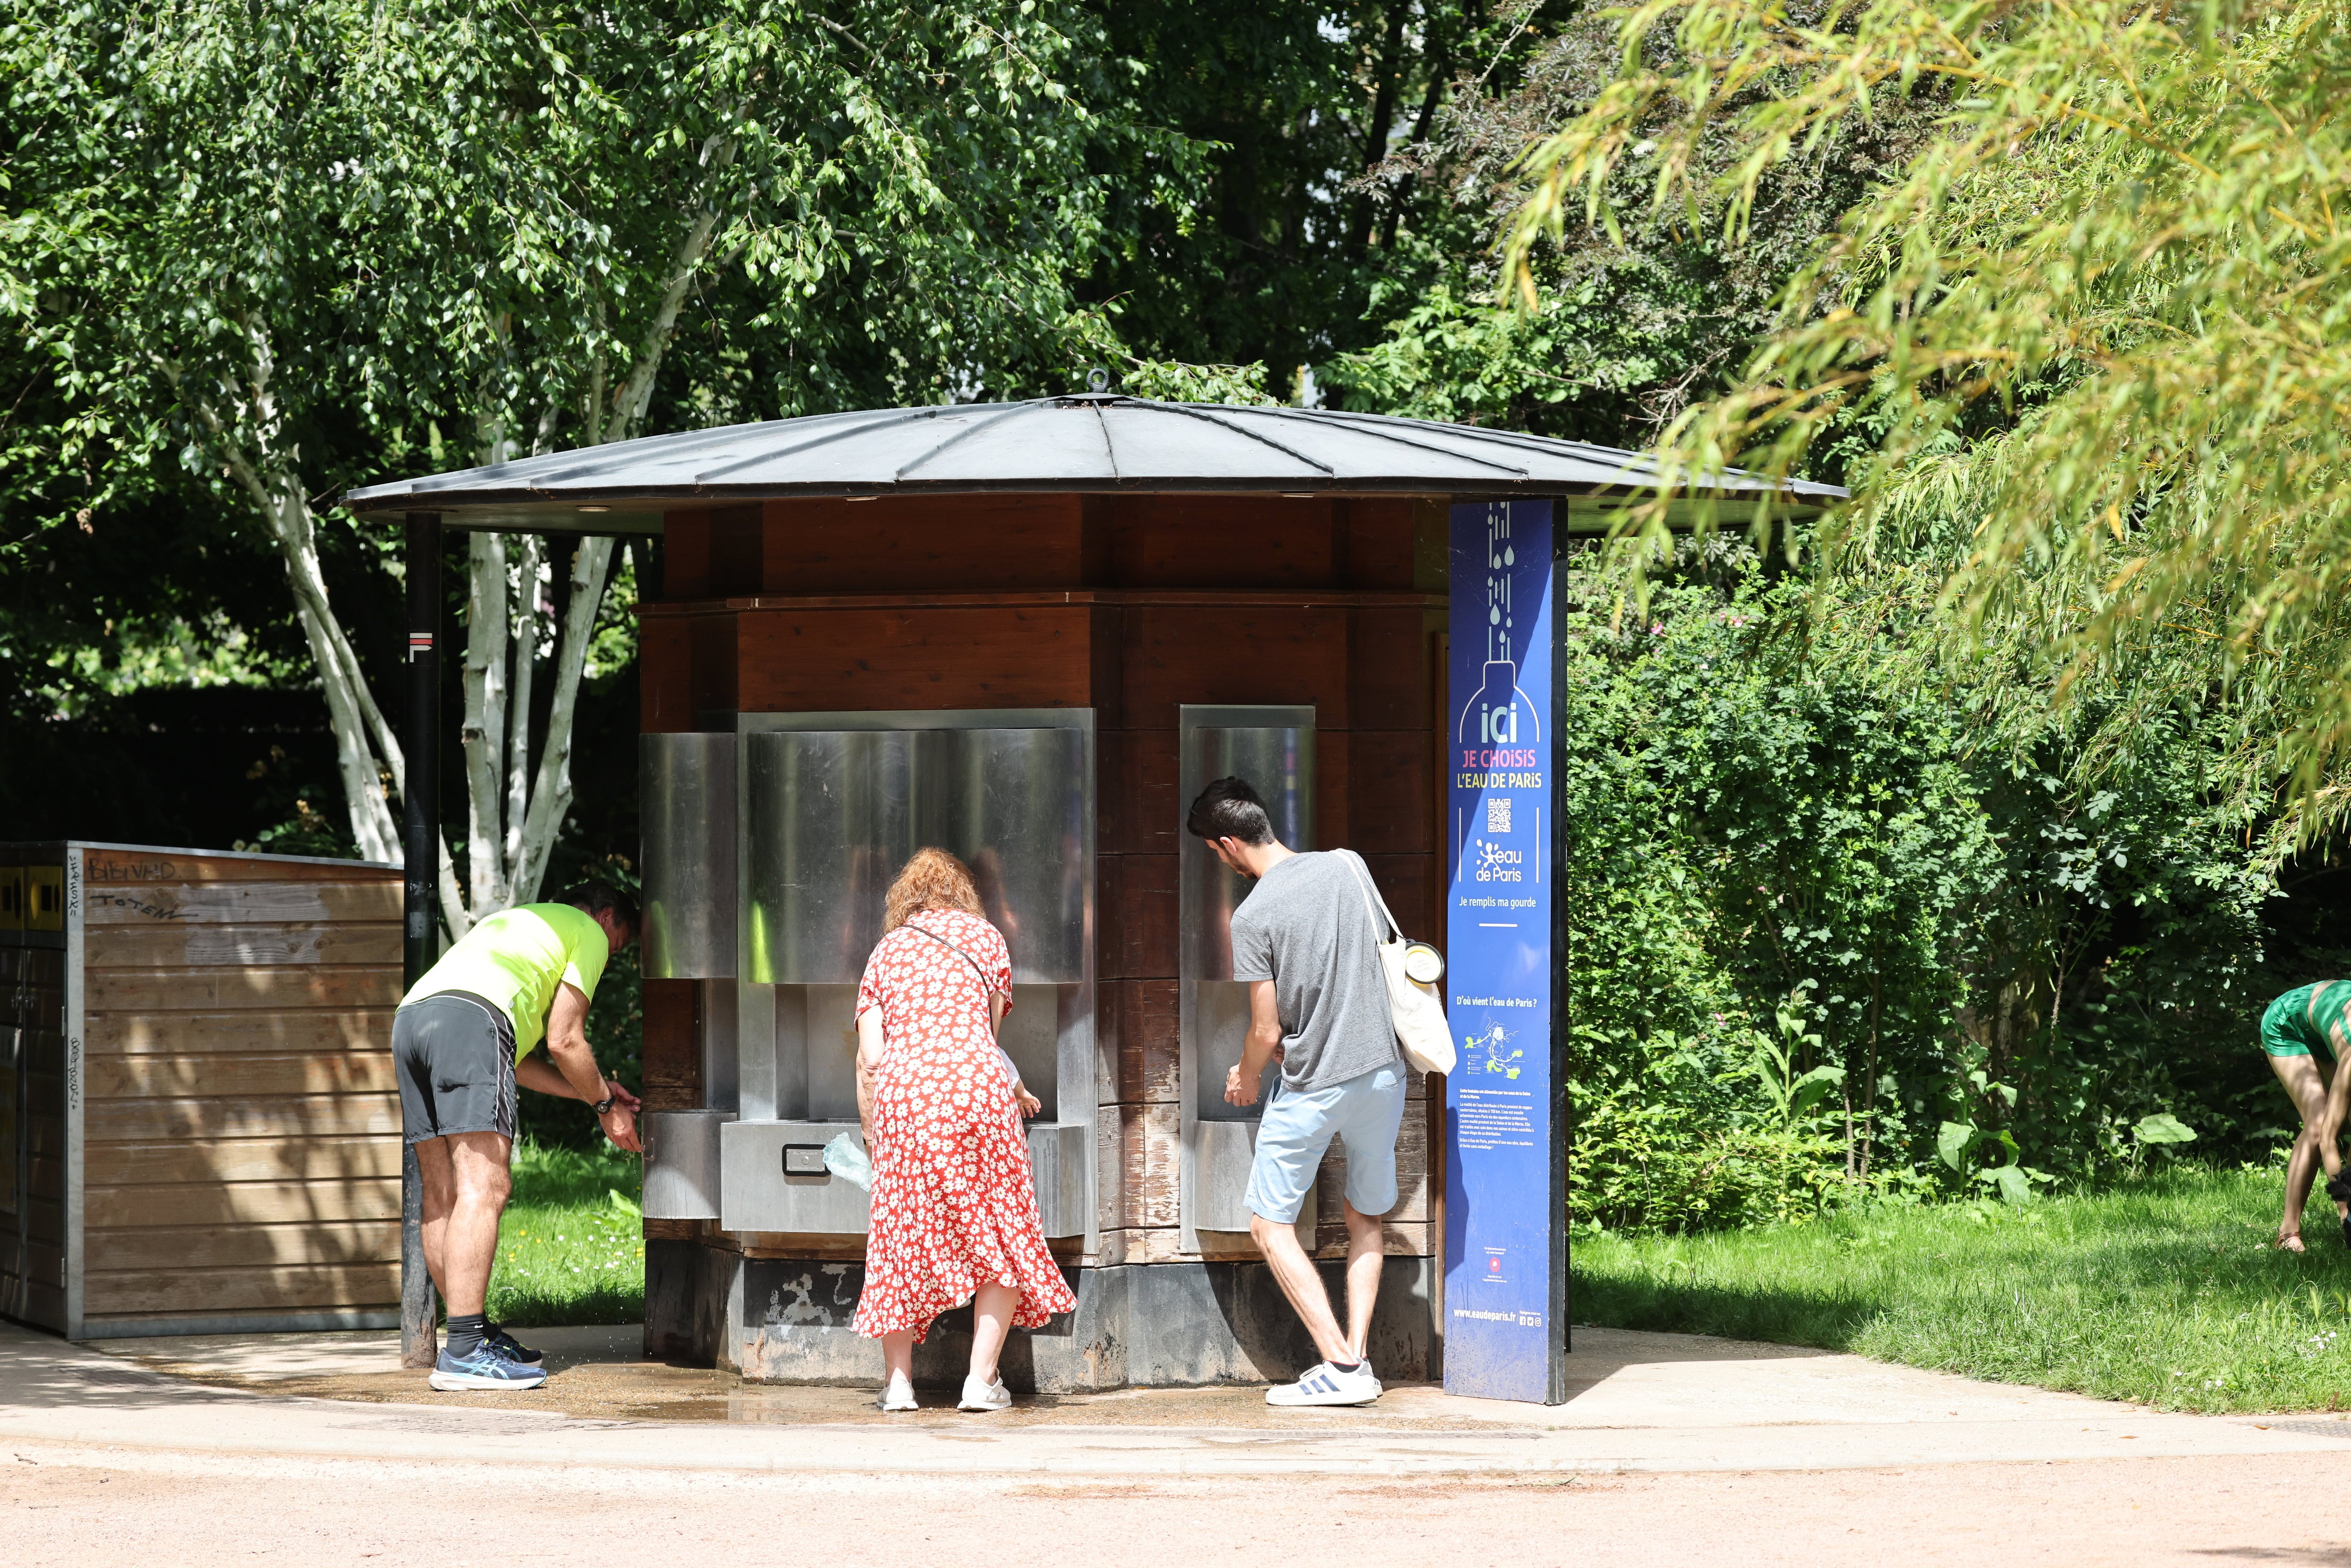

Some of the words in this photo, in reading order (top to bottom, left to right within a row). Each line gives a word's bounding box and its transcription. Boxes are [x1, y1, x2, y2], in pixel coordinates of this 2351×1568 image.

[1481, 702, 1517, 743] ici
[1463, 750, 1476, 768] JE
[1458, 773, 1488, 788] L'EAU
[1491, 773, 1506, 788] DE
[1497, 850, 1522, 864] eau
[1476, 869, 1491, 882] de
[1493, 867, 1522, 882] Paris
[1460, 897, 1467, 906] Je
[1469, 896, 1496, 909] remplis
[1511, 897, 1536, 909] gourde
[1457, 996, 1471, 1005] D'où
[1472, 997, 1488, 1005] vient
[1490, 996, 1505, 1006] l'eau
[1507, 998, 1514, 1007] de
[1516, 998, 1532, 1007] Paris
[1533, 999, 1537, 1007] ?
[1454, 1309, 1516, 1322] www.eaudeparis.fr
